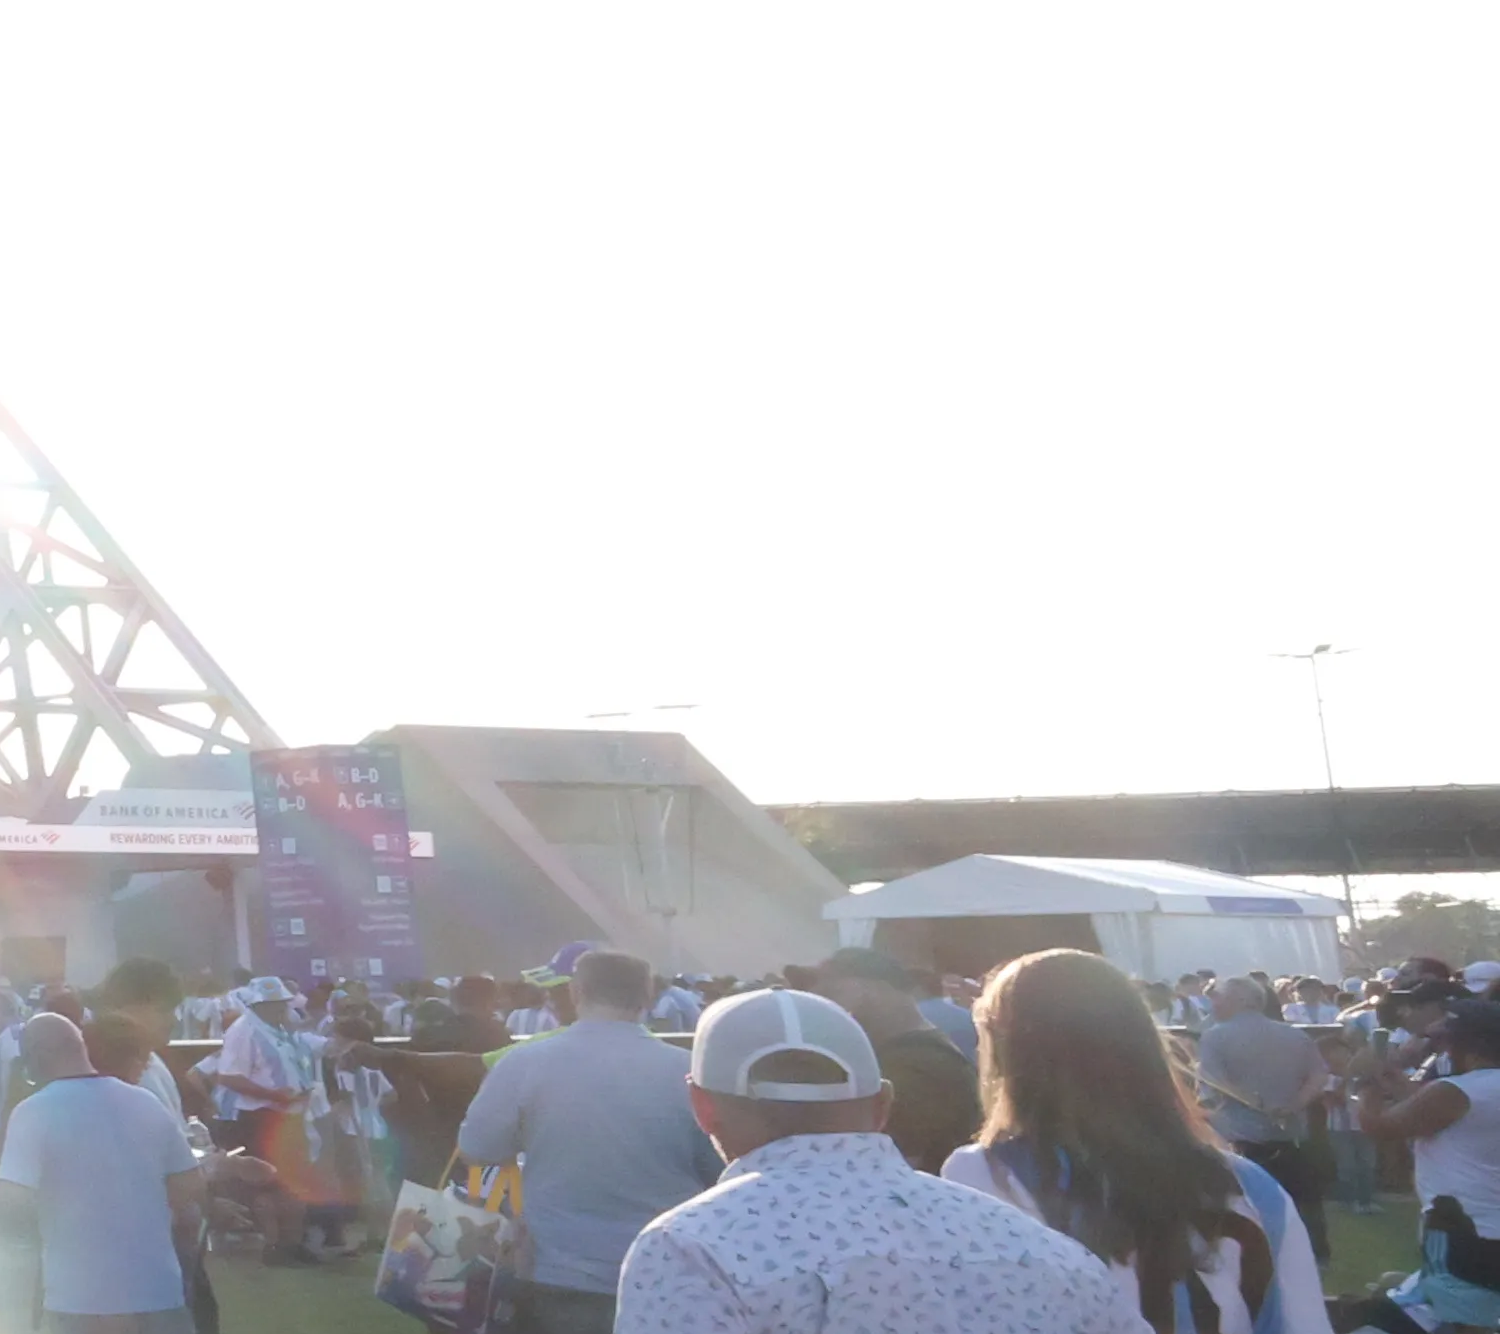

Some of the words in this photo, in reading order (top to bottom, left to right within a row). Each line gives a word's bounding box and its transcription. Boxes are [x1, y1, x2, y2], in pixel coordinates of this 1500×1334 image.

[99, 805, 139, 817] BANK
[143, 806, 161, 817] OF
[166, 807, 229, 819] AMERICA
[110, 833, 175, 845] REWARDING
[178, 834, 212, 845] EVERY
[217, 834, 259, 845] AMBITI
